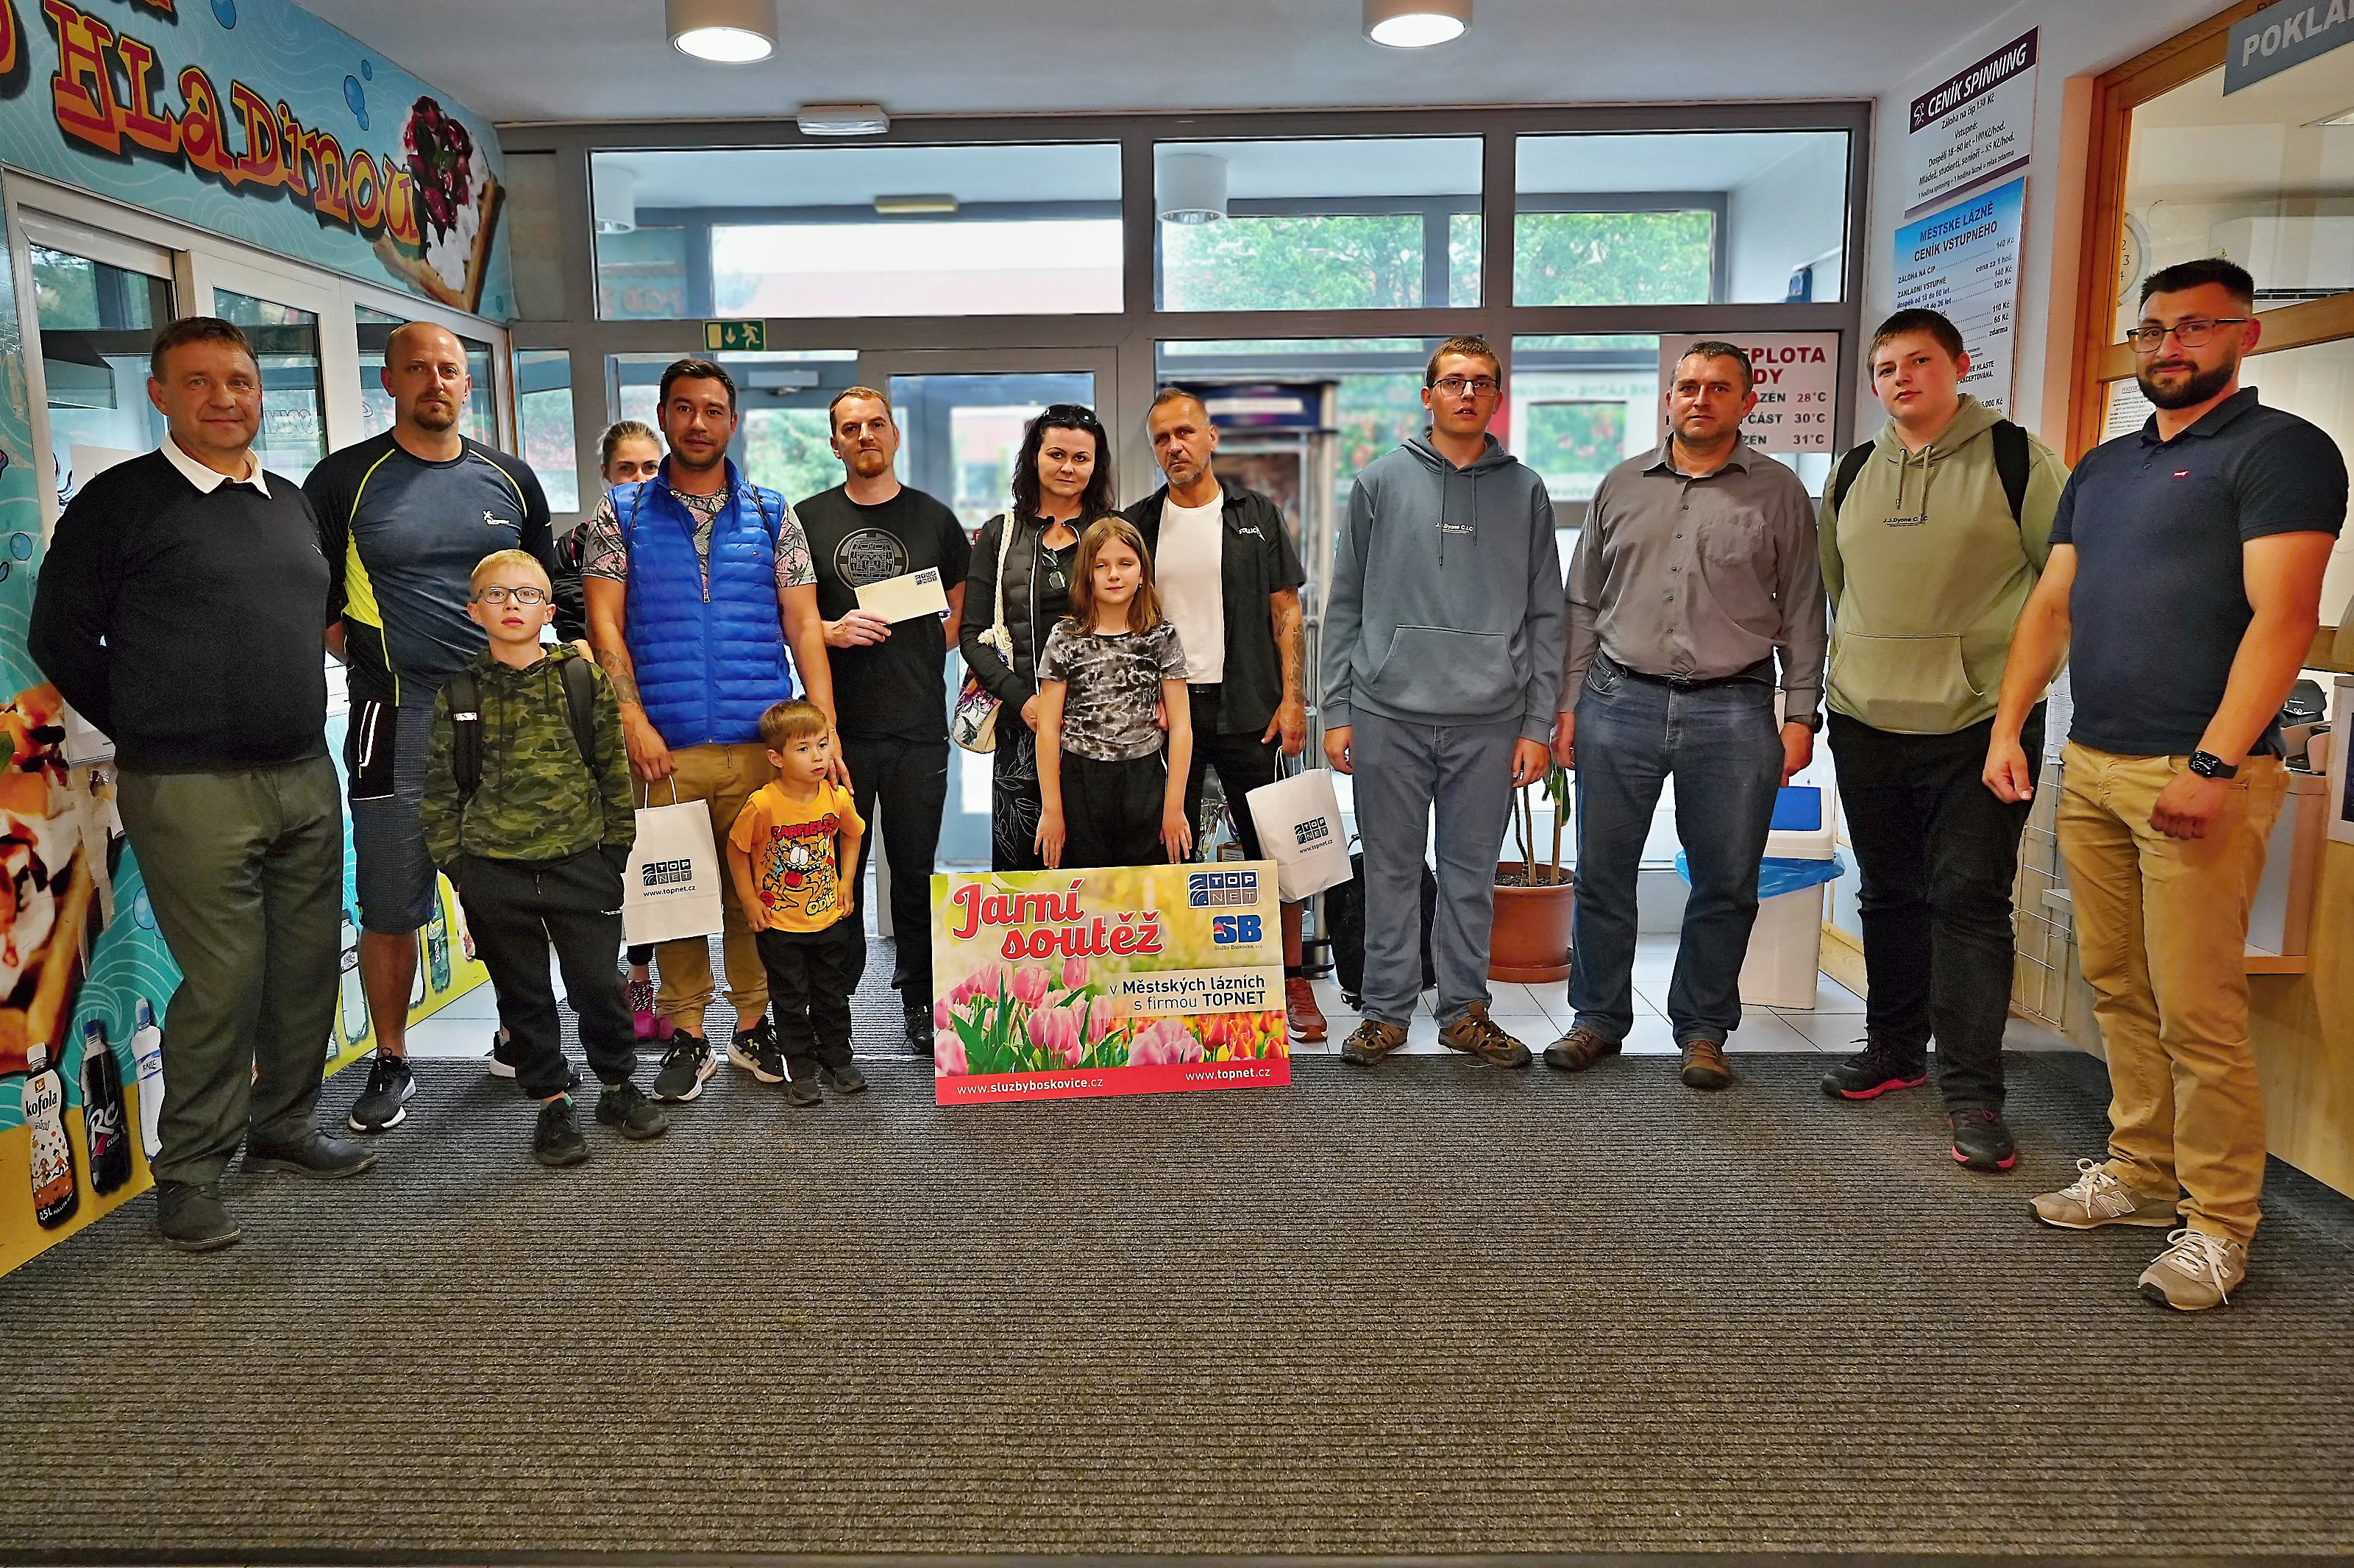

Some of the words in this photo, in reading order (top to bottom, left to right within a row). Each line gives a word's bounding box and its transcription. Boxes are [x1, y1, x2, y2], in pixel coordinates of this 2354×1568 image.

[2243, 0, 2354, 67] POKLA
[1928, 80, 1963, 116] CENÍK
[1964, 43, 2027, 97] SPINNING
[1942, 115, 1958, 129] Záloha
[1960, 110, 1966, 120] na
[1967, 106, 1976, 116] čip
[1988, 93, 1995, 104] Kč
[1955, 121, 1977, 139] Vstupné:
[1929, 151, 1948, 168] Dospělí
[1919, 170, 1938, 185] Mládež,
[1939, 159, 1960, 176] studenti,
[1921, 188, 1933, 198] hodina
[1934, 179, 1950, 193] spinning
[1957, 170, 1971, 180] hodina
[1971, 163, 1983, 175] lázně
[1986, 158, 1997, 168] relax
[1997, 150, 2014, 162] zdarma
[1920, 215, 1960, 242] MĚSTSKÉ
[1963, 201, 1994, 226] LÁZNĚ
[1914, 242, 1941, 262] CENÍK
[1943, 221, 1997, 252] VSTUPNÉHO
[1976, 263, 1988, 273] cena
[2123, 255, 2129, 265] 3
[2005, 266, 2012, 274] Kč
[1924, 277, 1946, 290] VSTUPNÉ
[1994, 280, 2003, 289] 120
[2005, 277, 2011, 285] Kč
[1993, 304, 2002, 313] 110
[2002, 301, 2010, 310] Kč
[1994, 316, 2001, 324] 65
[2002, 313, 2009, 321] Kč
[1989, 327, 2008, 336] zdarma
[1739, 347, 1826, 363] PLOTA
[1754, 368, 1784, 385] DY
[1757, 391, 1786, 402] ZÉN
[1797, 392, 1827, 402] 28°C
[1748, 412, 1782, 424] ČÁST
[1794, 413, 1825, 424] 30°C
[1743, 433, 1767, 446] ZÉN
[1793, 435, 1824, 444] 31°C
[1304, 819, 1324, 830] TOP
[1307, 828, 1326, 840] NET
[1299, 839, 1333, 853] www.topnet.cz
[658, 862, 690, 871] TOP
[659, 872, 690, 883] NET
[1211, 875, 1254, 885] TOP
[643, 885, 696, 897] www.topnet.cz
[1212, 892, 1254, 902] NET
[806, 890, 836, 915] ODIE
[953, 878, 1086, 941] Jarní
[1001, 910, 1164, 961] soutěž
[1212, 915, 1262, 944] SB
[1109, 984, 1118, 996] v
[1123, 977, 1205, 996] Městských
[1209, 974, 1265, 991] lázních
[1134, 1001, 1142, 1011] s
[1146, 994, 1198, 1010] firmou
[1203, 991, 1266, 1007] TOPNET
[1185, 1066, 1271, 1082] www.topnet.cz
[957, 1077, 1103, 1094] www.sluzbyboskovice.cz
[25, 1090, 57, 1118] kofola
[89, 1102, 118, 1151] RC
[107, 1133, 119, 1147] cola
[2095, 1190, 2136, 1218] N
